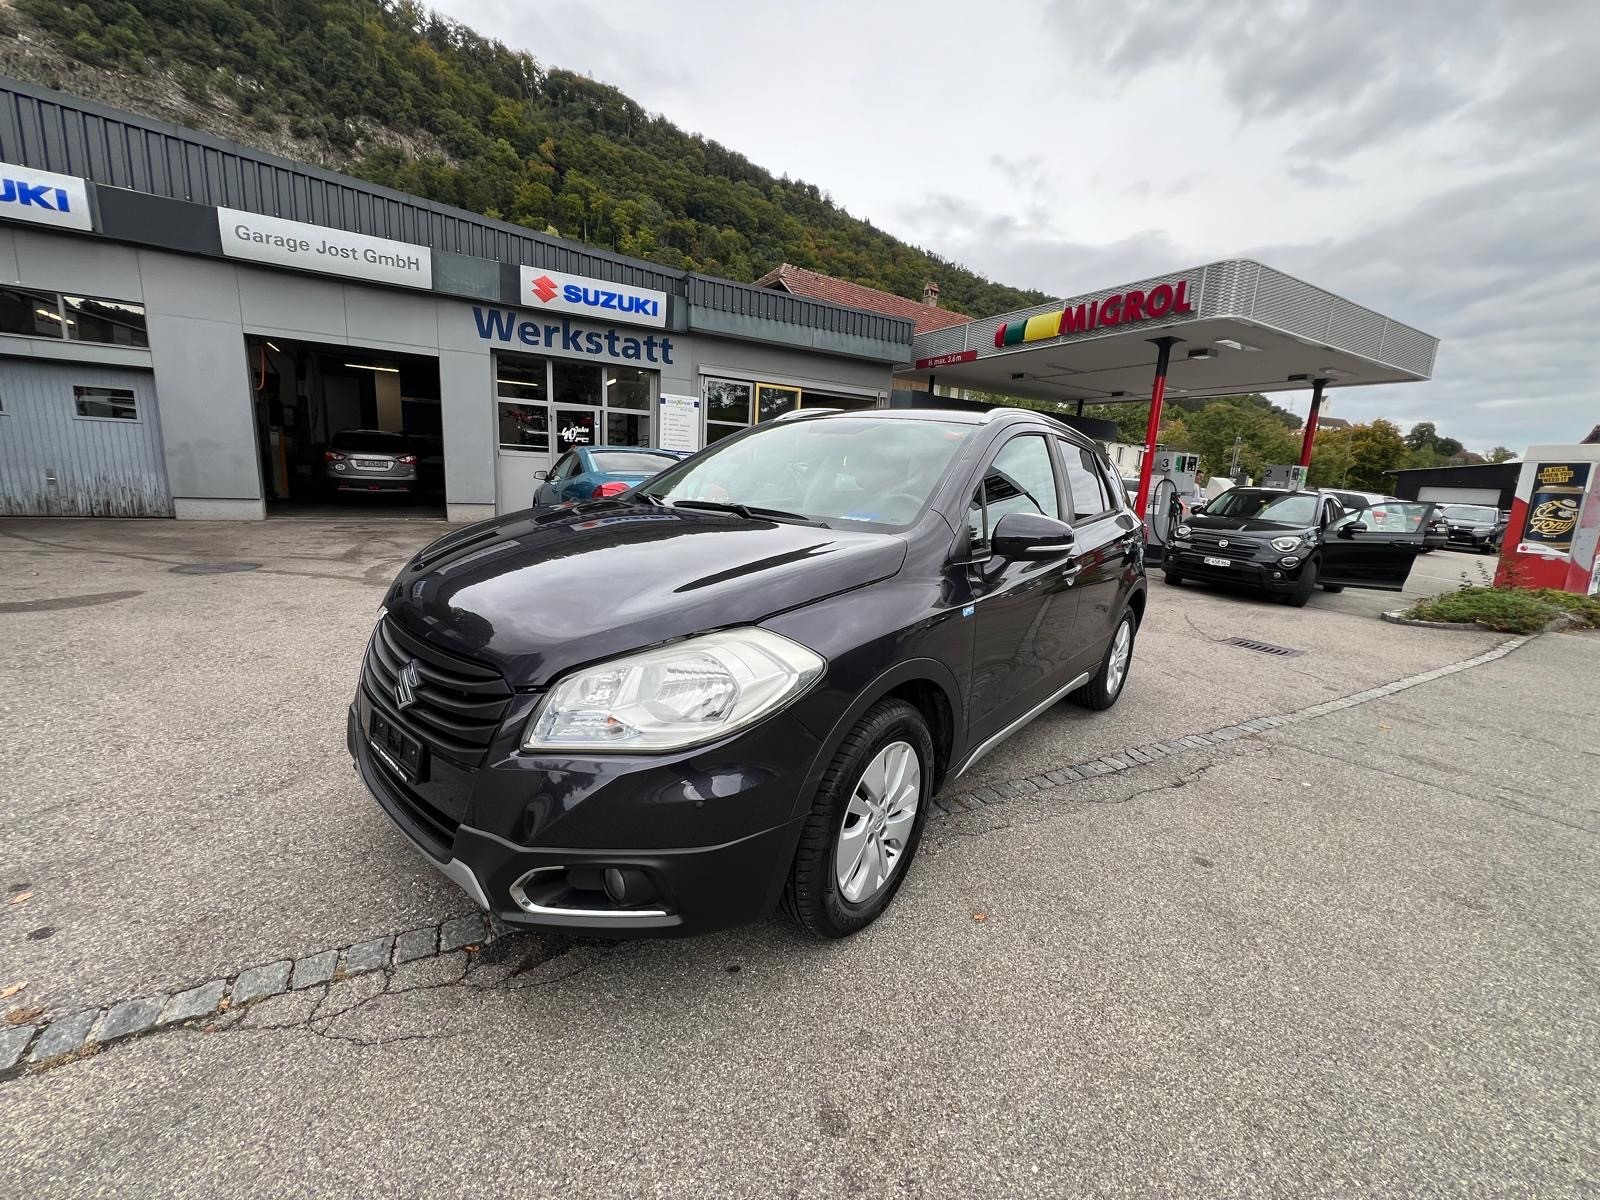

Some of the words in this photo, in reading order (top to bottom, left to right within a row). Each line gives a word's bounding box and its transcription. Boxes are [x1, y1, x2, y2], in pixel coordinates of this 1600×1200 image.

[234, 224, 310, 252] Garage
[316, 240, 359, 261] Jost
[363, 248, 420, 272] GmbH
[563, 284, 658, 317] SUZUKI
[1058, 280, 1191, 335] MIGROL
[472, 306, 674, 365] Werkstatt
[1162, 458, 1169, 468] 3
[1265, 469, 1272, 478] 2
[1285, 470, 1289, 478] 1
